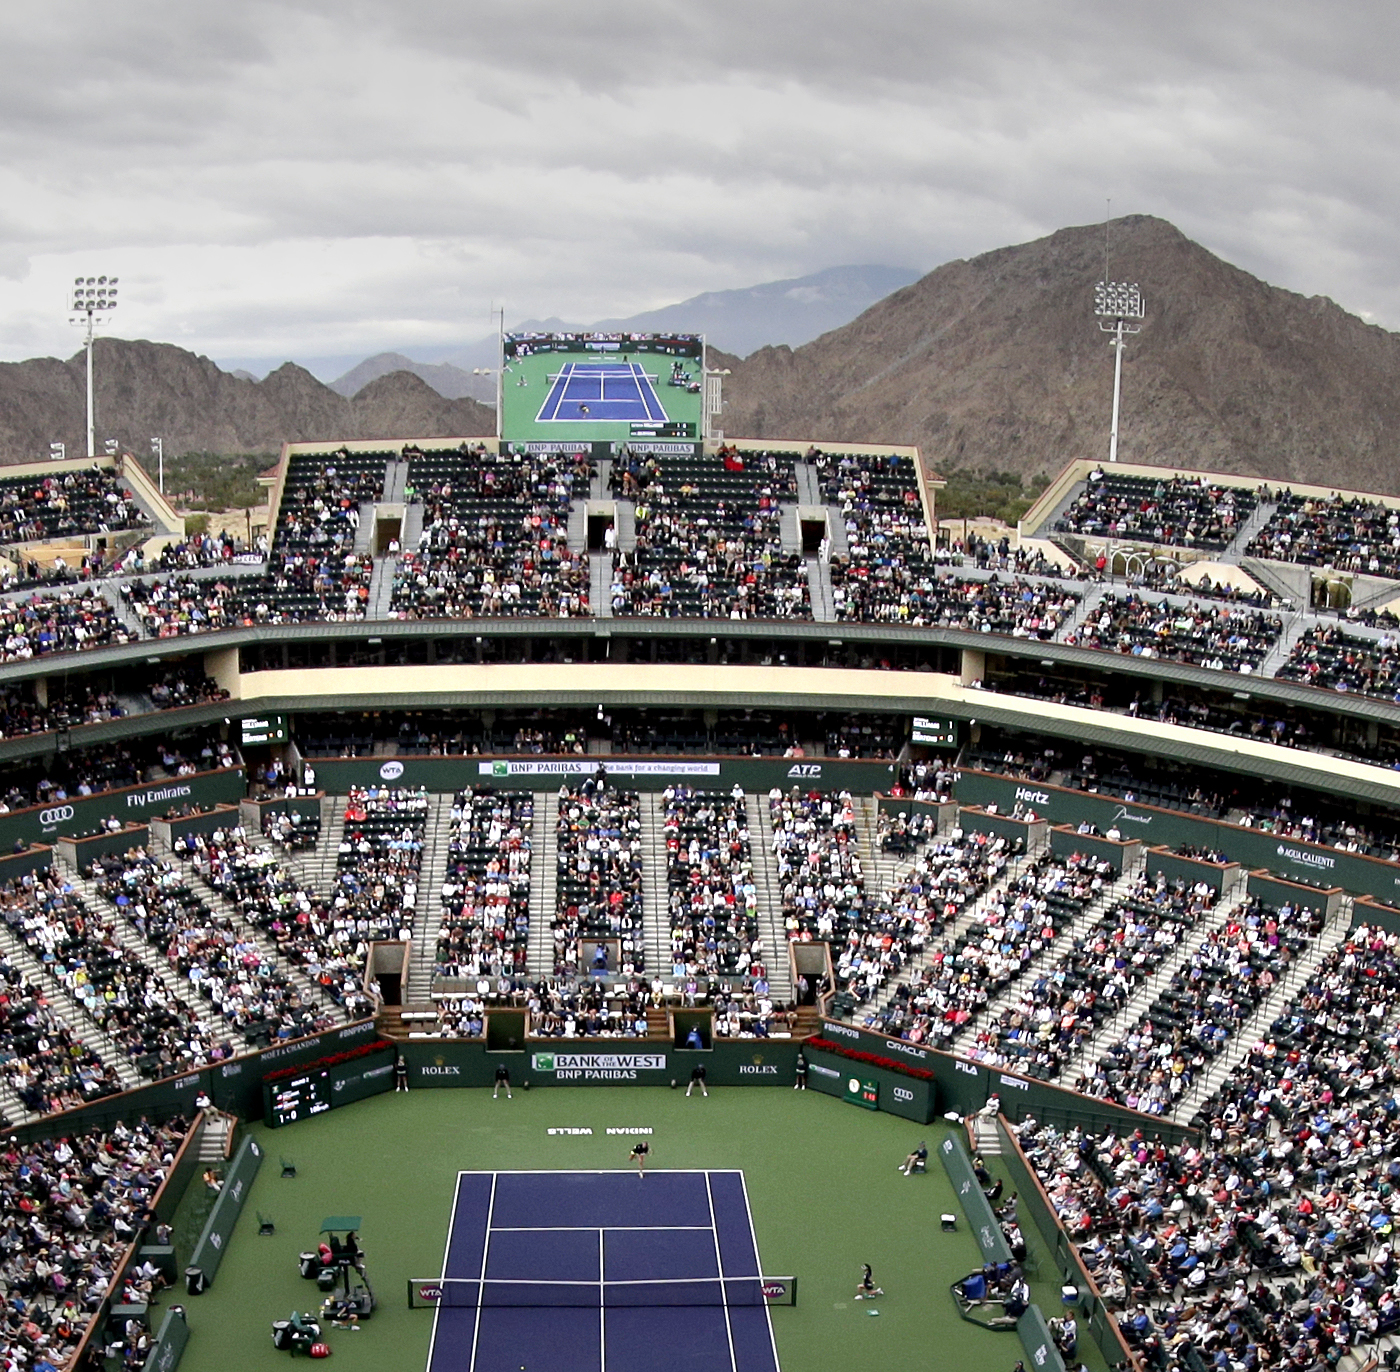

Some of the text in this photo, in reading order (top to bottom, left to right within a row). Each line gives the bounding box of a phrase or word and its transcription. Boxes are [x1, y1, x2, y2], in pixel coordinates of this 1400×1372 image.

[528, 443, 589, 453] BNP PARIBAS
[653, 444, 691, 453] PARIBAS
[511, 762, 534, 773] BNP
[537, 762, 582, 773] PARIBAS
[635, 764, 646, 772] for
[654, 764, 685, 773] changing
[789, 764, 822, 776] ATP
[127, 785, 191, 807] Fly Emirates
[1015, 787, 1050, 805] Hertz
[1284, 848, 1301, 861] AGUA
[1301, 852, 1336, 869] CALIENTE
[286, 1038, 321, 1054] CHANDON
[886, 1040, 927, 1058] ORACLE
[557, 1055, 601, 1067] BANK
[617, 1055, 663, 1067] WEST
[421, 1066, 460, 1075] ROLEX
[739, 1065, 777, 1074] ROLEX
[955, 1061, 979, 1075] FILA
[556, 1070, 637, 1079] BNP PARIBAS
[547, 1127, 653, 1135] INDIAN WELLS
